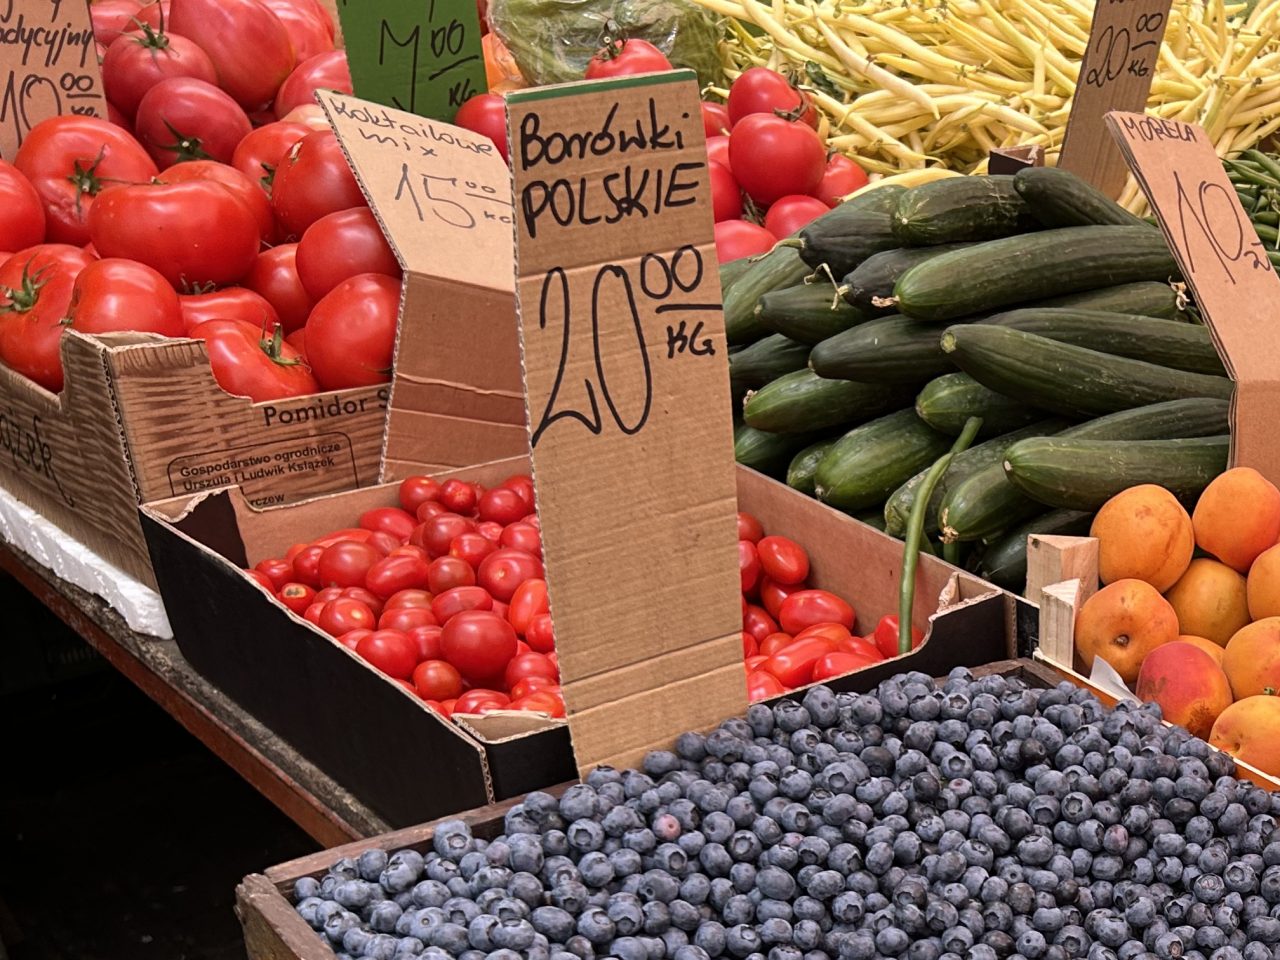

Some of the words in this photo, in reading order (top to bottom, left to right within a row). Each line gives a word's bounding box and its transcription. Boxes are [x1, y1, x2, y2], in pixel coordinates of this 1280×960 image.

[0, 14, 94, 68] dycyjny
[431, 19, 464, 58] 00
[1086, 25, 1131, 88] 20
[1136, 12, 1164, 33] 00
[60, 72, 94, 92] 00
[358, 128, 438, 158] mix
[520, 97, 689, 172] Borówki
[1120, 116, 1198, 143] MORELA
[395, 163, 476, 229] 15
[521, 162, 705, 239] POLSKIE
[1173, 170, 1244, 285] 10
[530, 263, 653, 449] 20
[640, 243, 704, 300] 00
[666, 320, 716, 360] KG
[263, 394, 370, 427] Pomidor
[180, 454, 271, 478] Gospodarstwo
[274, 442, 341, 464] ogrodnicze
[183, 475, 231, 492] Urszula
[234, 473, 240, 484] i
[241, 463, 286, 482] Ludwik
